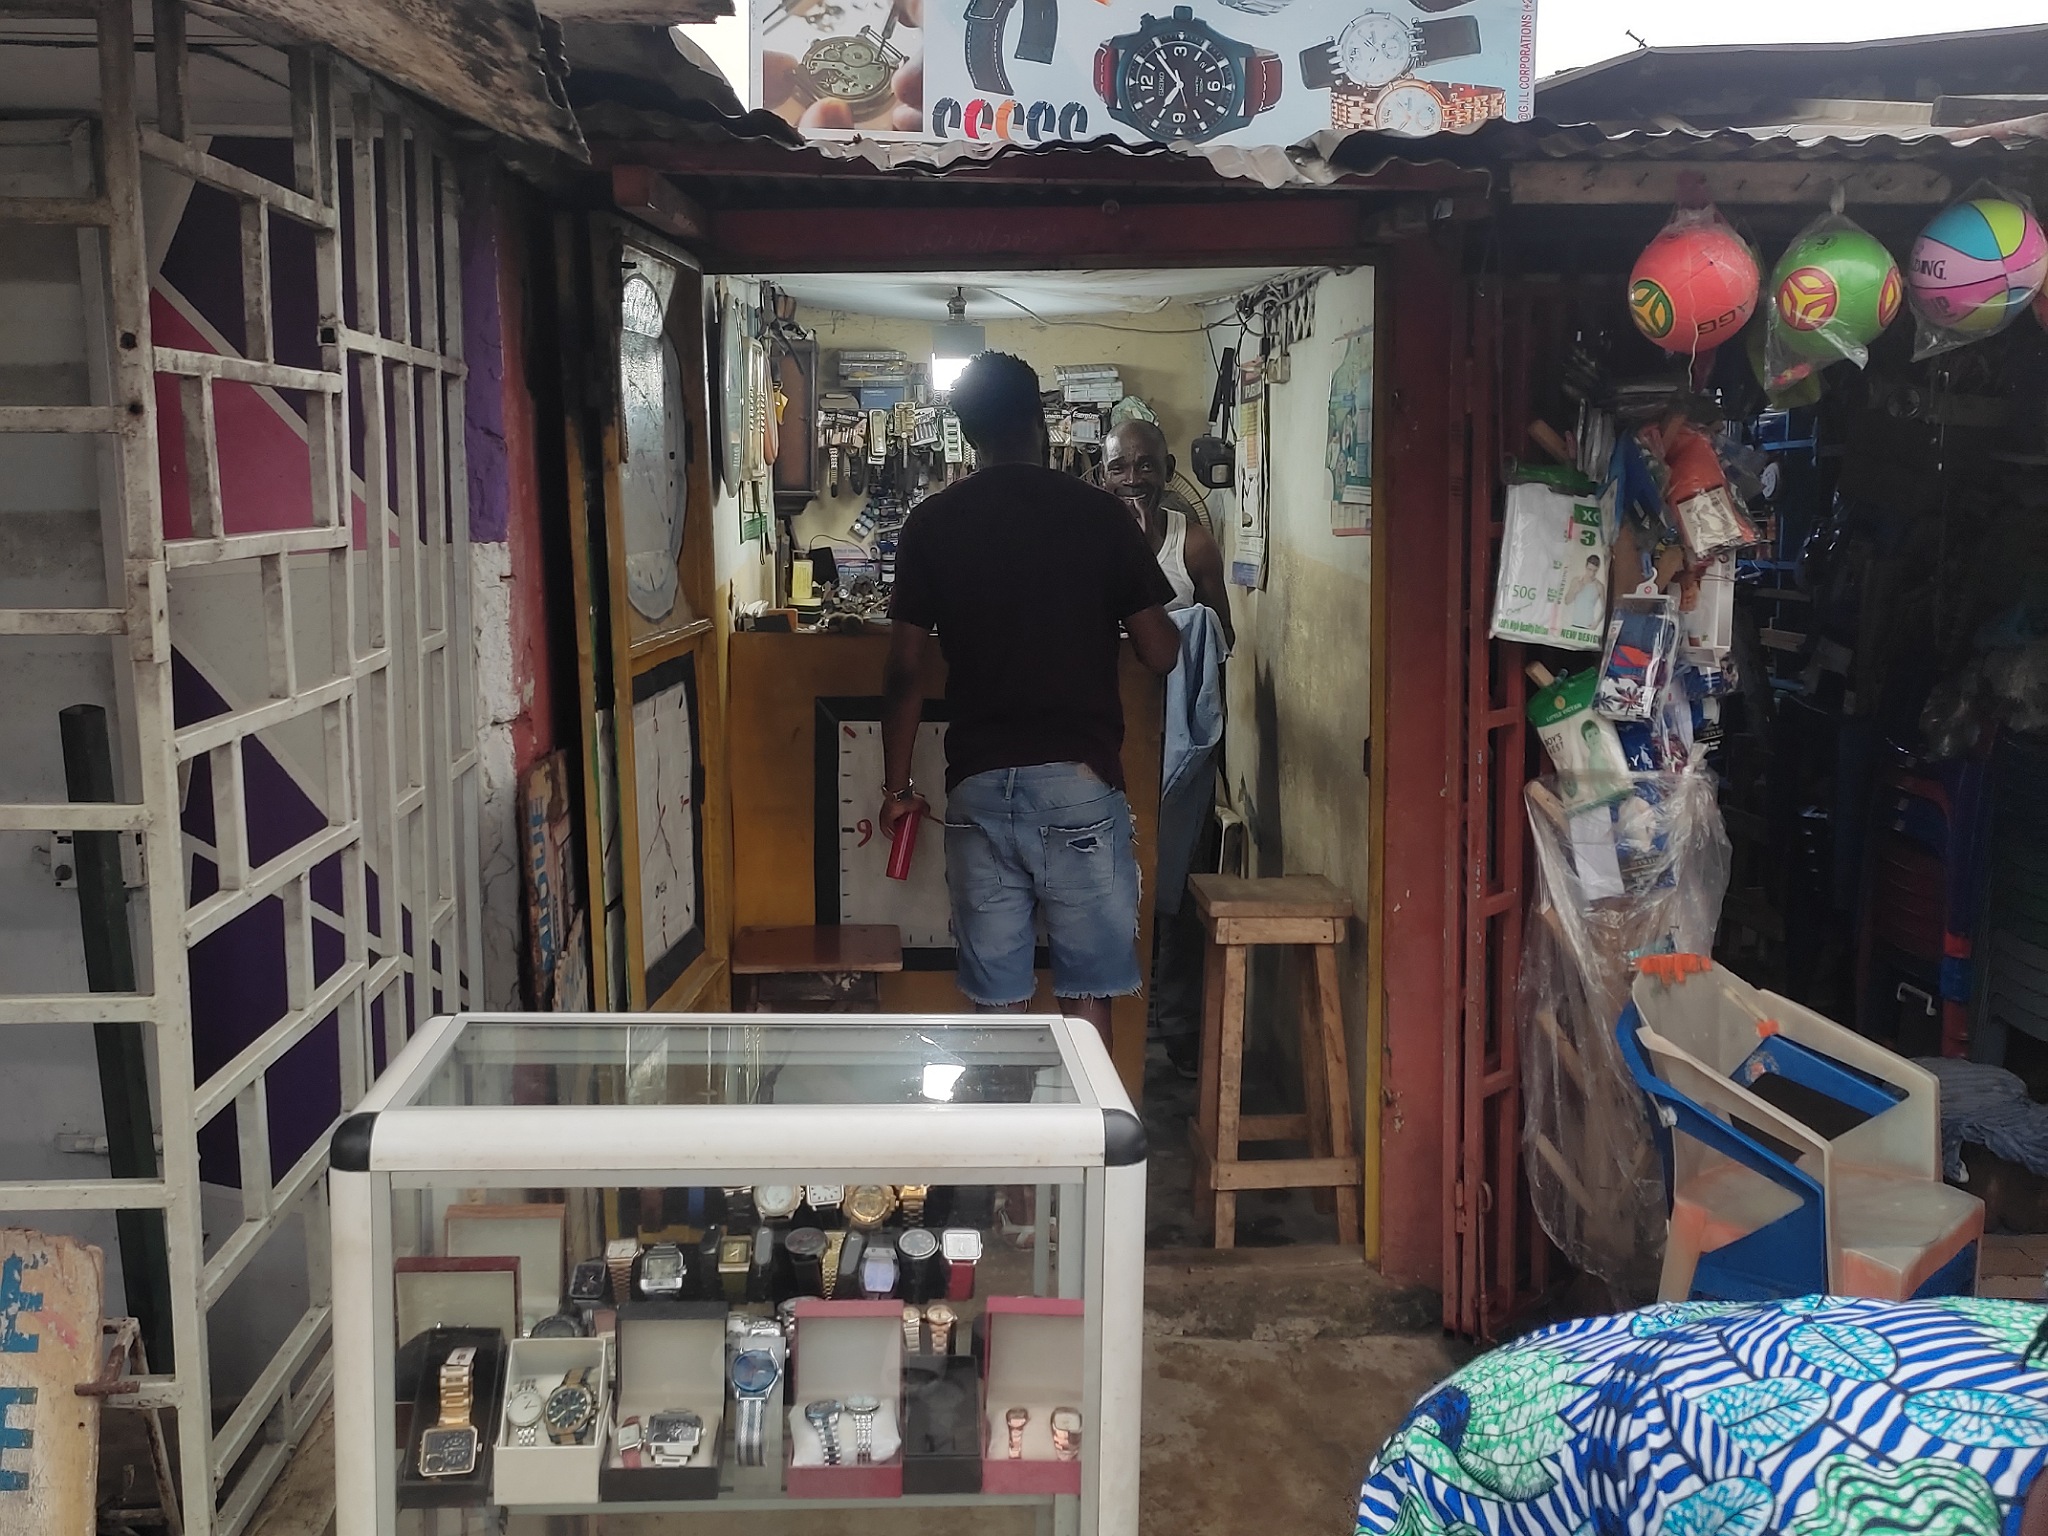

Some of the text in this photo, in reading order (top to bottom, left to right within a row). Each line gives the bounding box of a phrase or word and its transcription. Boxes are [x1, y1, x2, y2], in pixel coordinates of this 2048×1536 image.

[1173, 46, 1188, 57] 3
[1519, 14, 1532, 90] CORPORATIONS
[1140, 75, 1154, 92] 12
[1207, 81, 1221, 92] 6
[1172, 112, 1186, 123] 9
[1580, 530, 1596, 547] 3
[1561, 628, 1601, 645] NEW DESIG
[856, 818, 873, 848] 9
